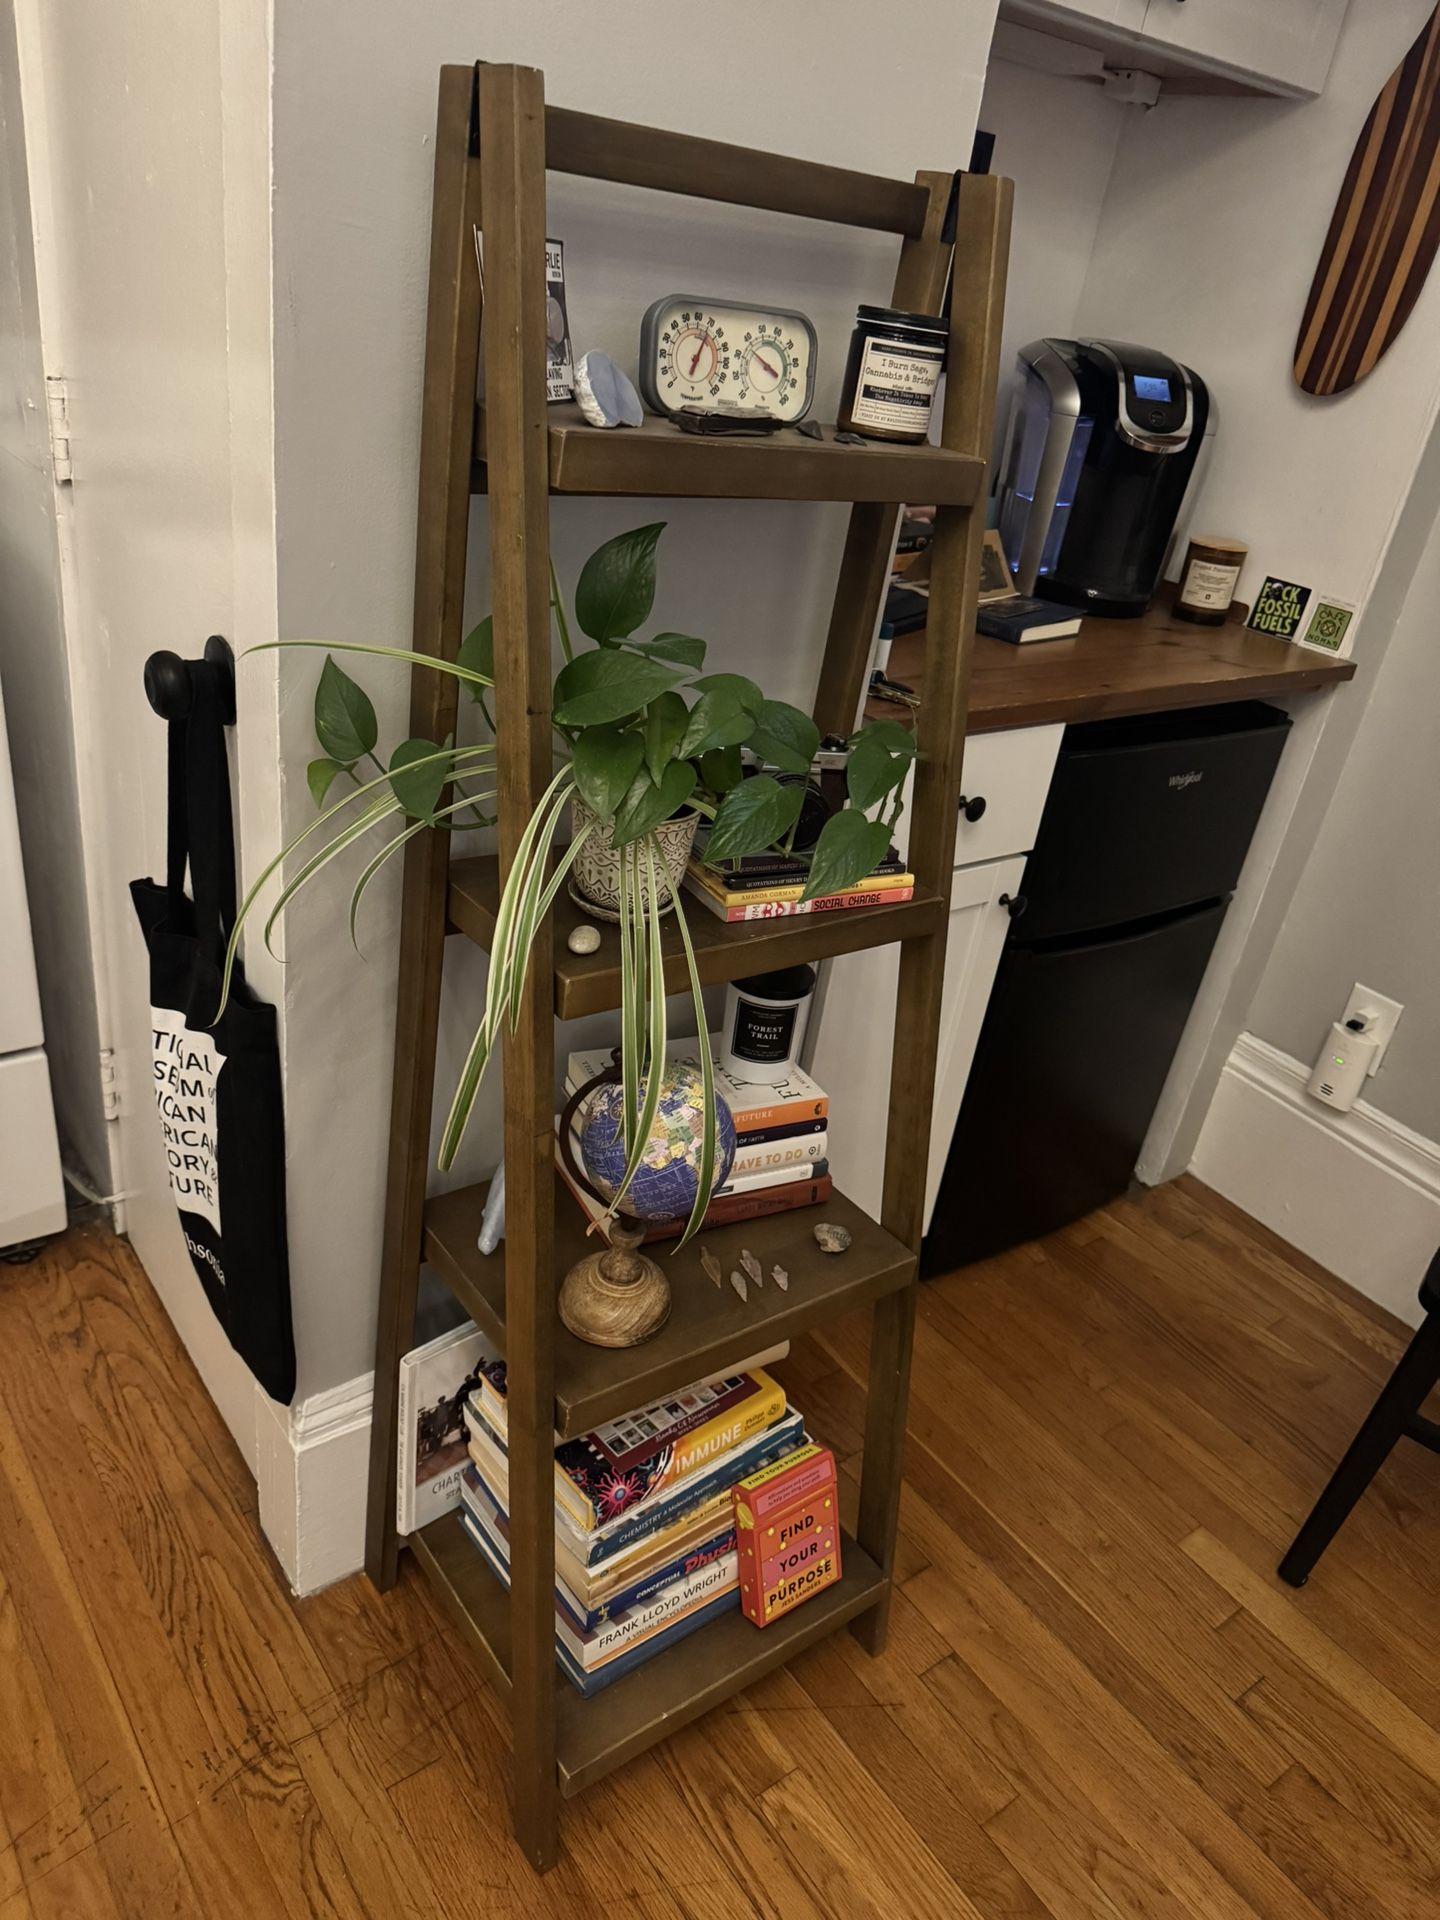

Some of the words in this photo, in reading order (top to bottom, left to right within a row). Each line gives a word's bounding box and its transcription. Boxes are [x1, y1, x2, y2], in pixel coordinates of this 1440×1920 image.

[682, 312, 690, 323] 50
[694, 312, 702, 321] 60
[706, 316, 716, 328] 70
[670, 320, 679, 330] 40
[758, 324, 766, 334] 50
[774, 326, 782, 336] 60
[662, 332, 671, 344] 30
[716, 328, 724, 338] 80
[744, 332, 752, 342] 40
[722, 342, 729, 352] 90
[786, 339, 794, 350] 70
[659, 348, 667, 359] 20
[734, 349, 742, 360] 30
[722, 356, 730, 370] 100
[792, 358, 799, 368] 80
[881, 358, 887, 367] I
[888, 359, 909, 371] Burn
[660, 366, 668, 376] 10
[732, 370, 740, 380] 20
[865, 366, 903, 381] Cannabis
[904, 374, 910, 382] &
[718, 372, 726, 384] 110
[790, 378, 798, 388] 90
[710, 384, 720, 397] 120
[738, 390, 746, 400] 10
[1262, 582, 1302, 602] FCK
[1257, 598, 1301, 620] FOSSIL
[1252, 612, 1292, 634] FUELS
[746, 880, 778, 888] QUOTATIONS
[769, 890, 796, 898] GORMAN
[814, 897, 844, 910] SOCIAL
[848, 893, 882, 906] CHANGE
[748, 1023, 784, 1033] FOREST
[751, 1031, 779, 1040] TRAIL
[154, 1060, 204, 1098] SEM
[736, 1110, 774, 1123] FUTURE
[732, 1157, 762, 1172] HAVE
[765, 1153, 782, 1165] TO
[785, 1148, 803, 1162] DO
[675, 1423, 742, 1474] IMMUNE
[748, 1474, 765, 1485] FIND
[766, 1464, 783, 1475] YOUR
[784, 1448, 814, 1465] PURPOSE
[618, 1513, 663, 1544] CHEMISTRY
[668, 1493, 694, 1512] Molecular
[780, 1514, 814, 1542] FIND
[780, 1542, 818, 1572] YOUR
[636, 1570, 681, 1600] CONCEPTUAL
[769, 1560, 832, 1606] PURPOSE
[781, 1597, 794, 1608] JESS
[795, 1580, 821, 1598] SANDERS
[598, 1618, 640, 1649] FRANK
[642, 1595, 680, 1622] LLOYD
[683, 1566, 728, 1599] WRIGHT
[632, 1622, 656, 1639] VISUAL
[656, 1594, 704, 1629] ENCYCLOPEDIA
